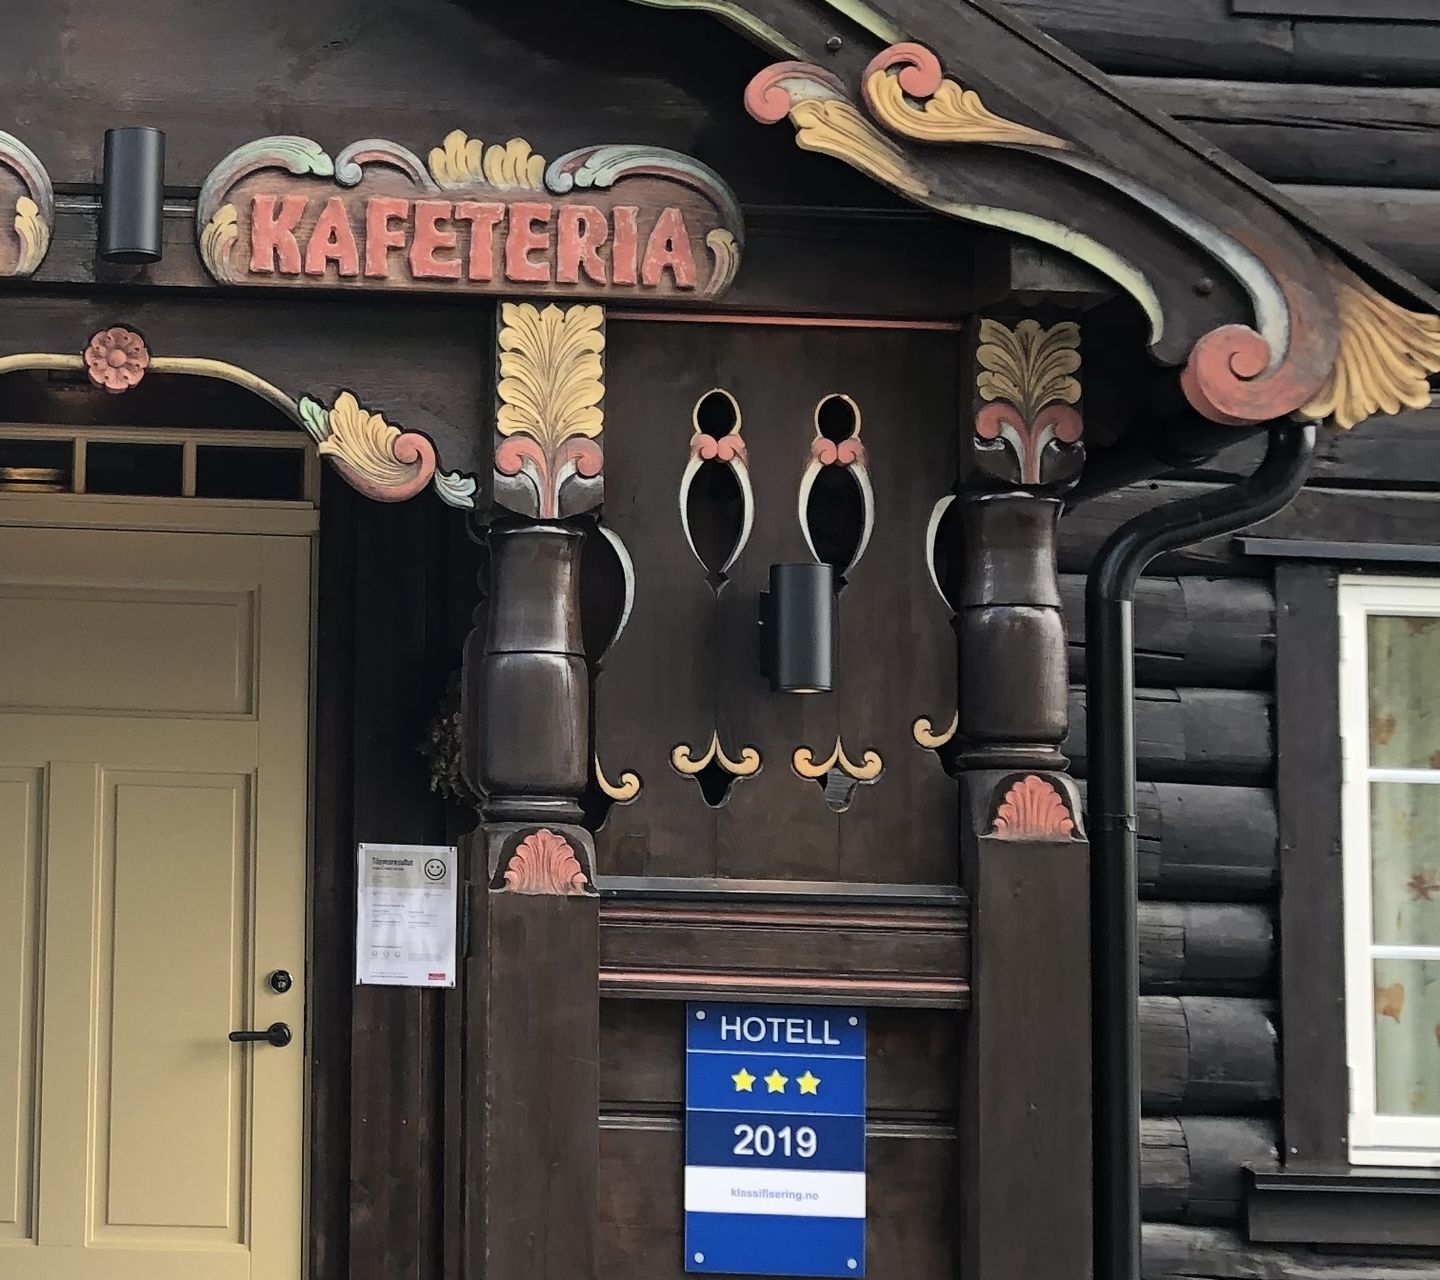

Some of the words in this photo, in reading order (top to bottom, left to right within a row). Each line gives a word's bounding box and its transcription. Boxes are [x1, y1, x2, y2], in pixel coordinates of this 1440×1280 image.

[249, 194, 697, 289] KAFETERIA
[720, 1015, 841, 1045] HOTELL
[732, 1123, 818, 1158] 2019
